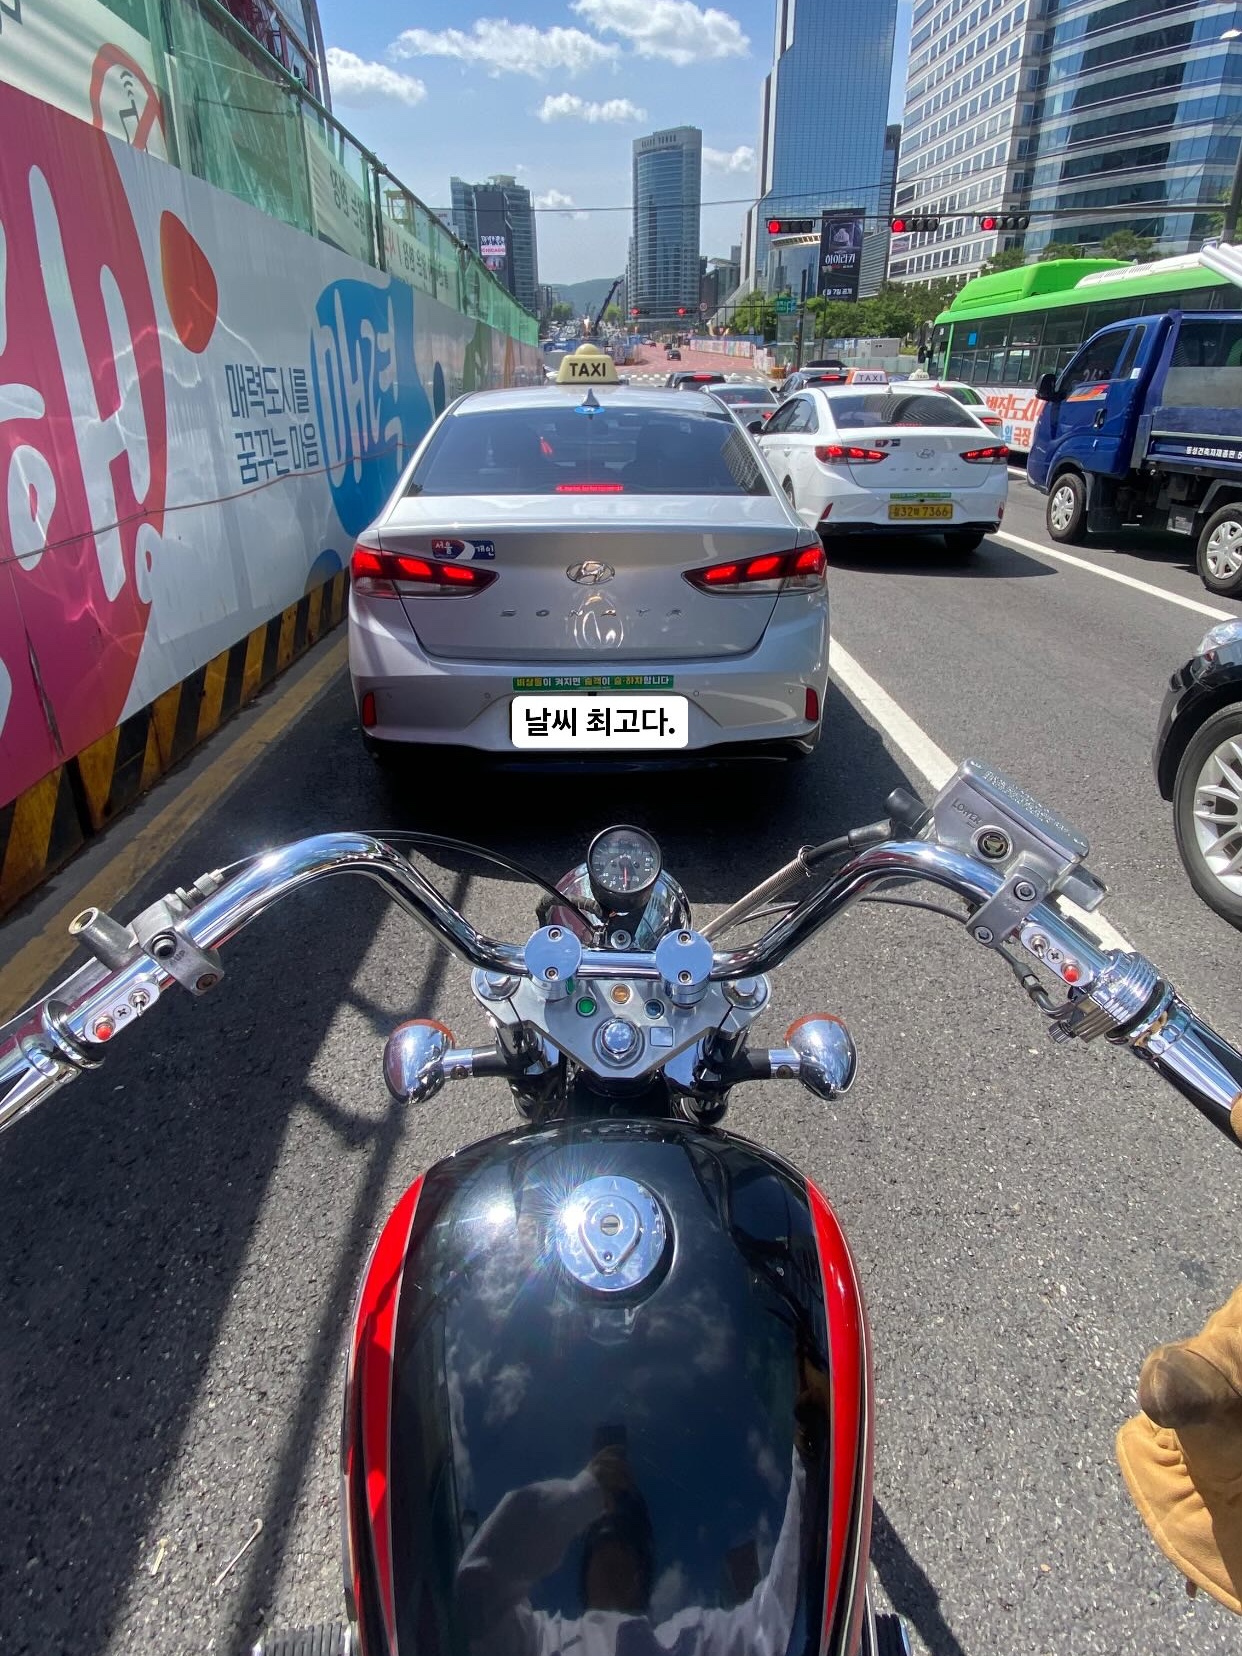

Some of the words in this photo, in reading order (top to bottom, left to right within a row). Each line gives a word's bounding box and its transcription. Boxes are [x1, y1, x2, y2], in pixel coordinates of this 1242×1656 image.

[569, 363, 606, 377] TAXI
[225, 364, 309, 418] 매력도시를
[922, 506, 948, 517] 7366
[435, 541, 453, 554] 서울
[474, 545, 495, 556] 개인
[500, 609, 682, 618] SONATA
[555, 677, 581, 686] 켜지면
[951, 798, 982, 824] LOWER
